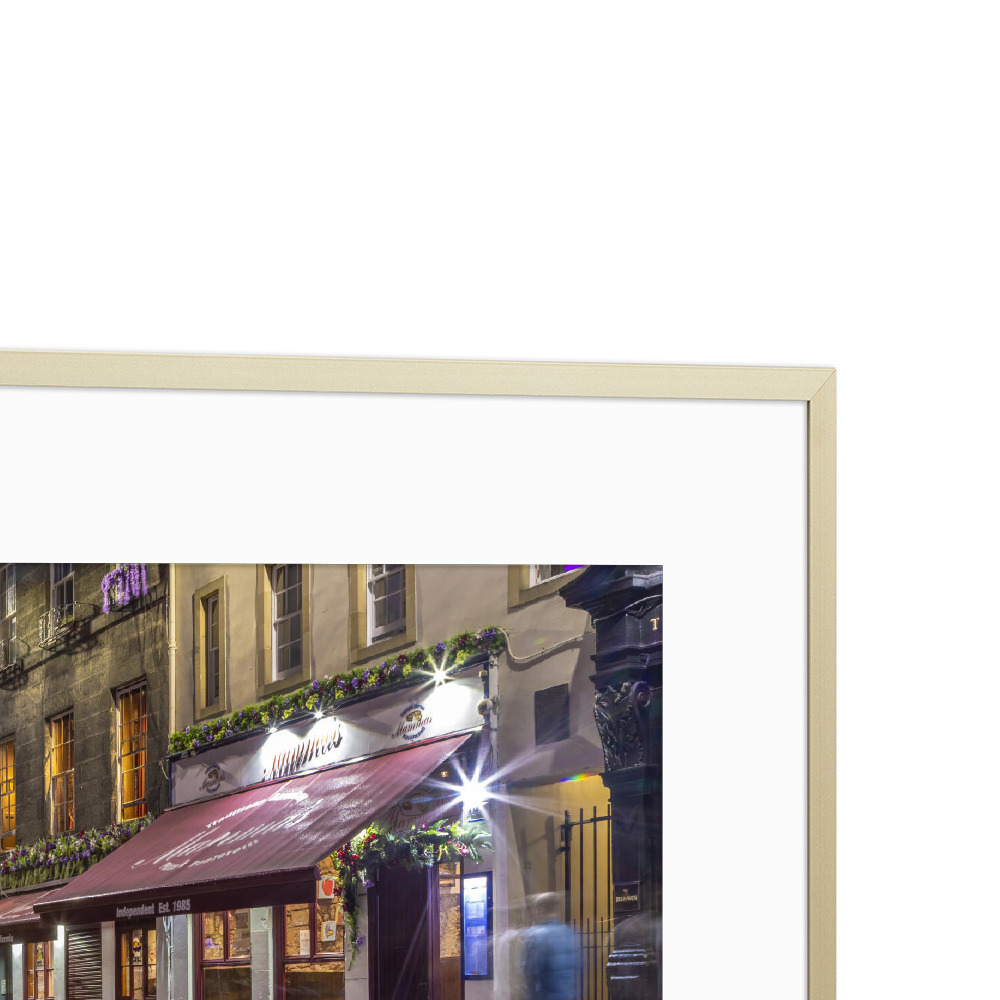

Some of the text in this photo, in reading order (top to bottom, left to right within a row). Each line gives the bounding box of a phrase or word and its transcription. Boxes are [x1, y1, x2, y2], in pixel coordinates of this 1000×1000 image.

[115, 898, 191, 919] Independent Est. 1985
